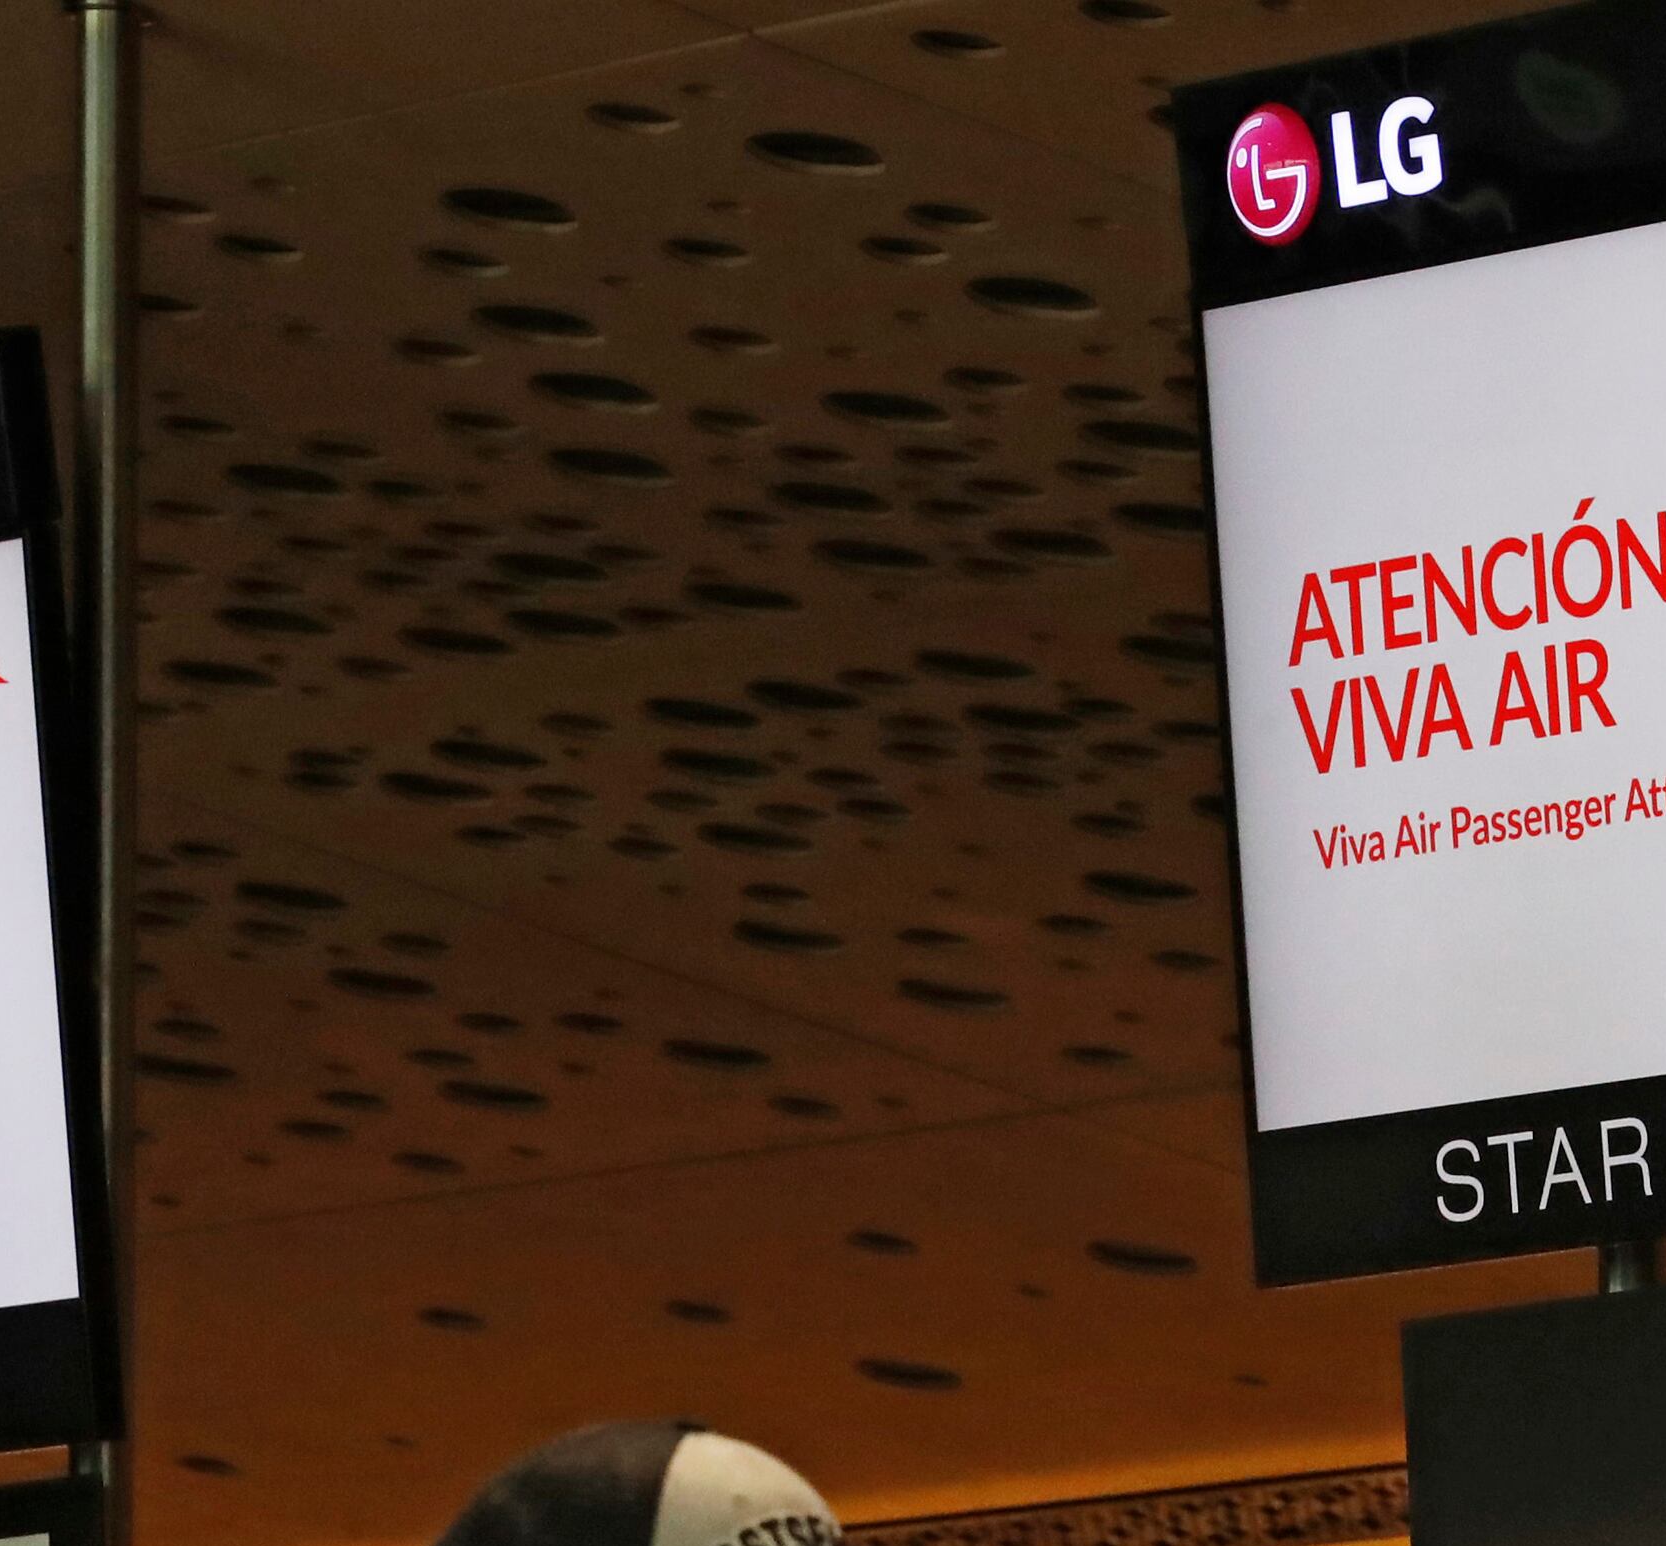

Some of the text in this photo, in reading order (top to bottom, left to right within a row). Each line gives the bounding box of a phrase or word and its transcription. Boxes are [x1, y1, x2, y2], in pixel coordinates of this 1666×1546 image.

[1332, 97, 1442, 208] LG
[1289, 639, 1617, 774] VIVA AIR
[1314, 824, 1385, 869] Viva
[1395, 812, 1441, 857] Air
[1451, 794, 1617, 848] Passenger
[1437, 1118, 1652, 1221] STAR
